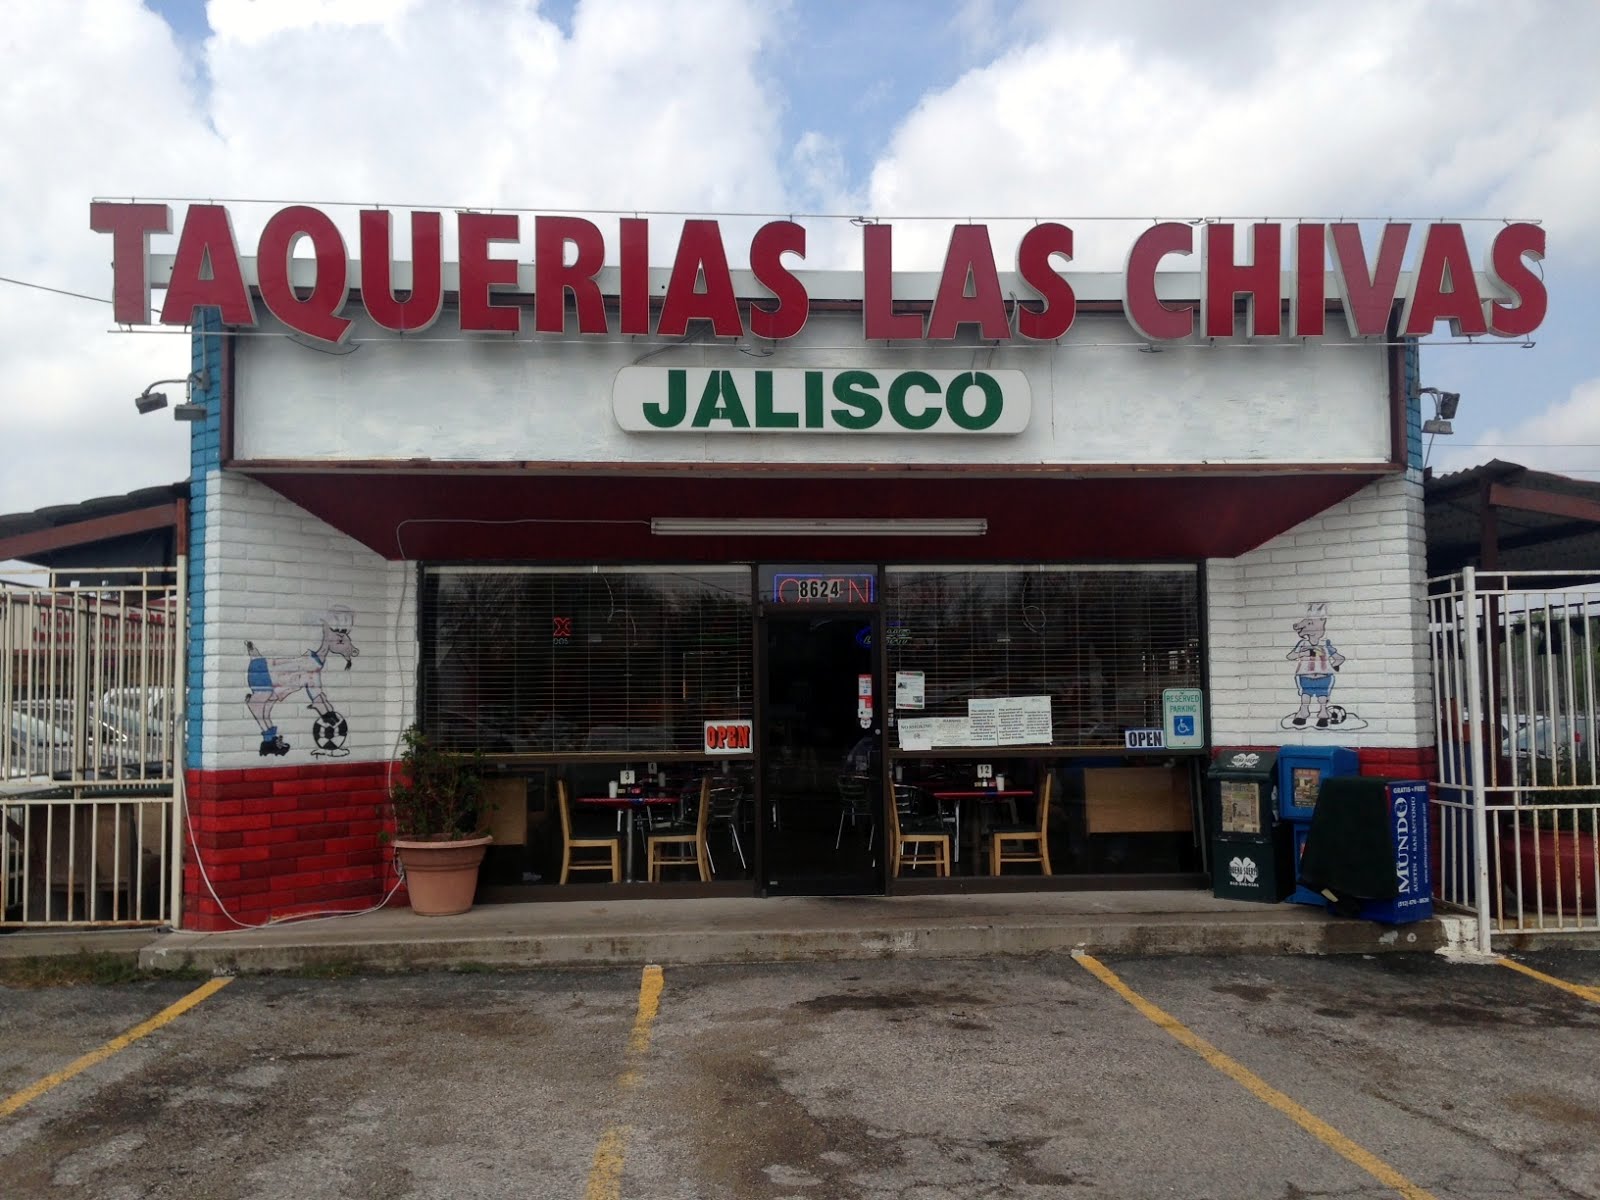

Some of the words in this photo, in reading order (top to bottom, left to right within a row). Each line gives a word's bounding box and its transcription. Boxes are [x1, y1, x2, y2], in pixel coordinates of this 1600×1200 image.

[90, 203, 809, 343] TAQUERIAS
[863, 222, 1076, 341] LAS
[1122, 222, 1547, 340] CHIVAS
[642, 369, 1003, 433] JALISCO
[799, 580, 839, 598] 8624
[1166, 695, 1200, 703] RESERVED
[1170, 704, 1197, 713] PARKING
[707, 725, 750, 749] OPEN
[1128, 731, 1162, 747] OPEN
[625, 772, 630, 780] 3
[980, 765, 990, 774] 12
[1393, 786, 1411, 794] GRATIS
[1394, 797, 1410, 894] MUNDO
